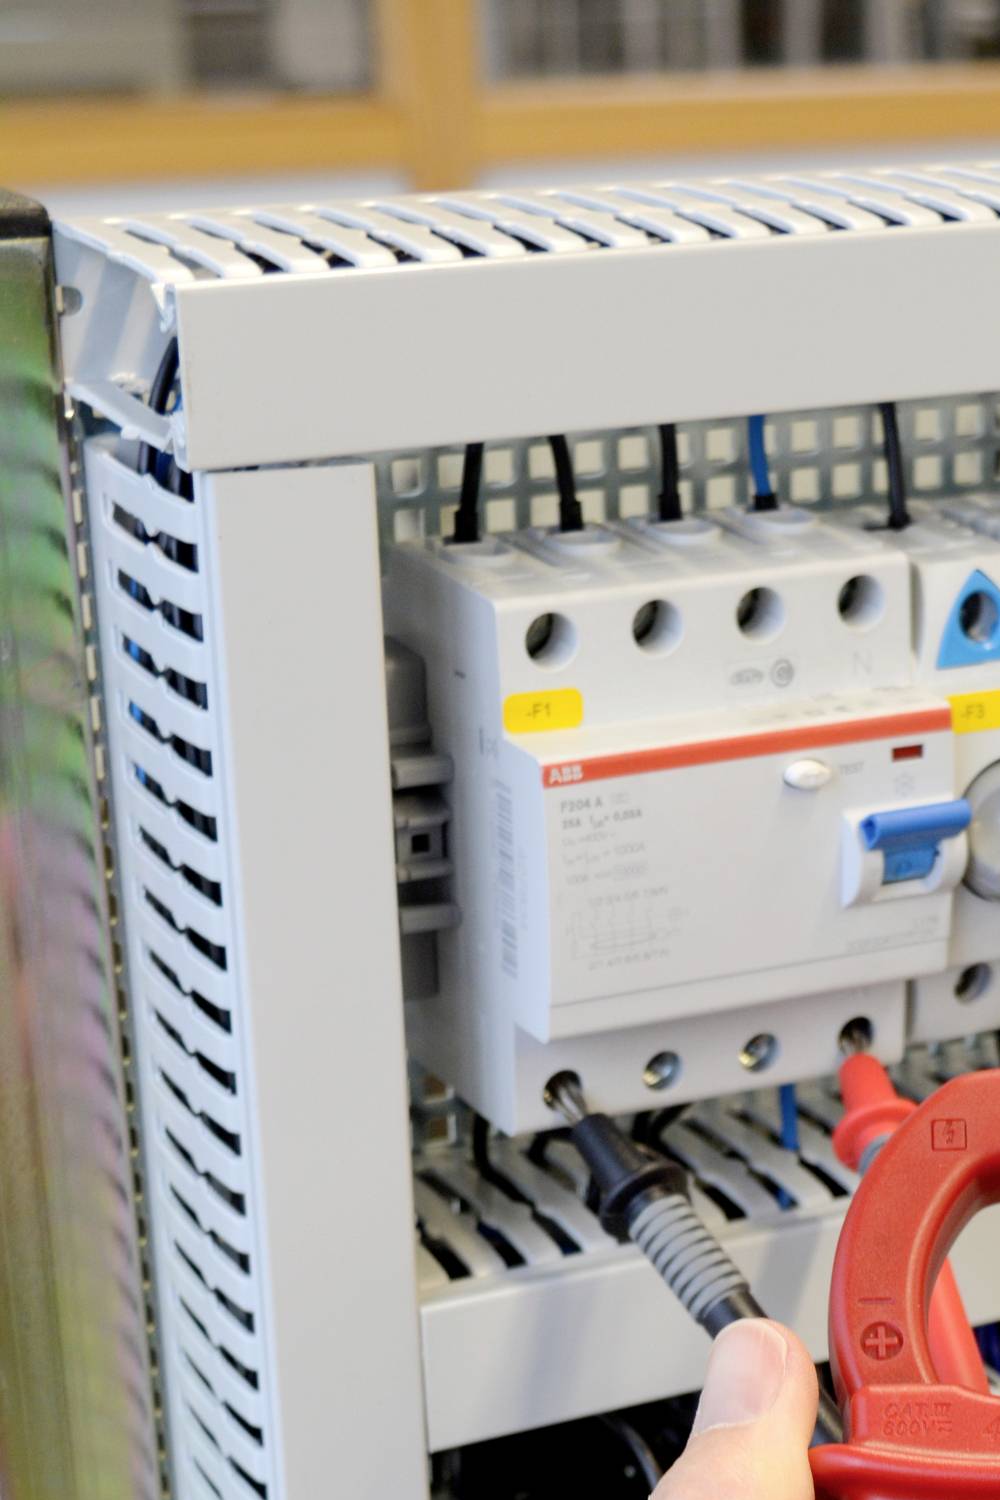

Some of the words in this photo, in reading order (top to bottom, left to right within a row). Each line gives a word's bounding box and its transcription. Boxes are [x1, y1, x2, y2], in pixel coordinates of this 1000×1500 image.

[526, 702, 550, 719] -F1
[549, 765, 583, 784] ABB
[561, 798, 591, 813] F204
